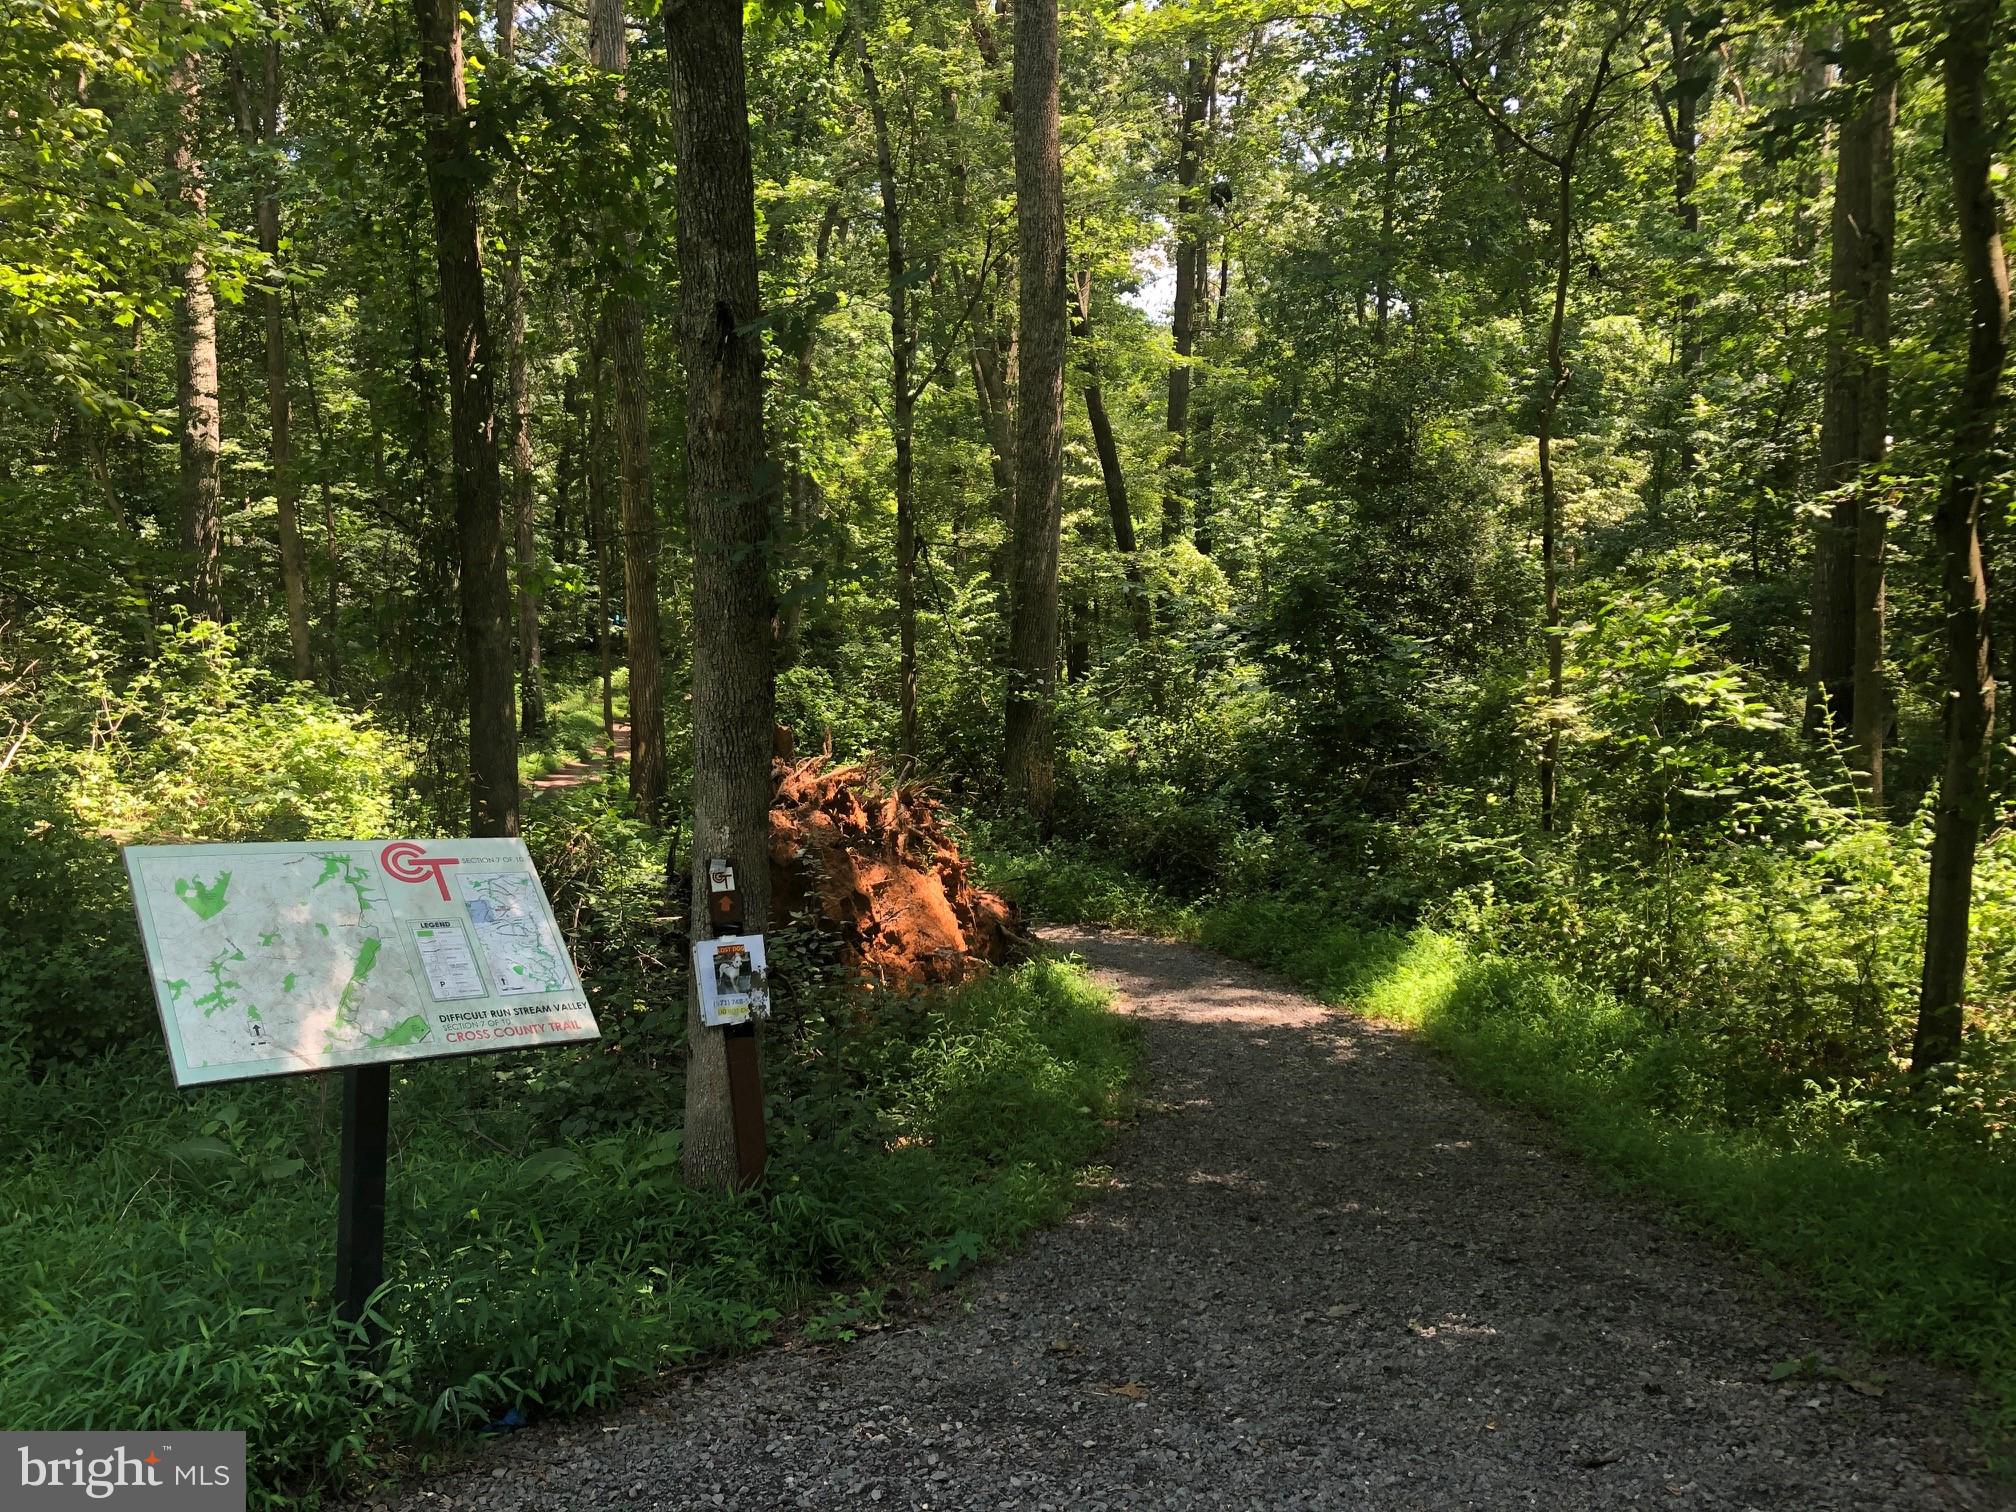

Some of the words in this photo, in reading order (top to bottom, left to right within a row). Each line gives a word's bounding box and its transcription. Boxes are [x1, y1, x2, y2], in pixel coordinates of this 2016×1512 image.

[439, 1011, 488, 1023] DIFFICULT
[490, 1009, 511, 1018] RUN
[513, 1005, 552, 1016] STREAM
[553, 1001, 587, 1012] VALLEY
[442, 1022, 479, 1032] SECTION
[487, 1019, 500, 1027] OF
[501, 1018, 512, 1026] 10
[446, 1029, 491, 1043] CROSS
[493, 1023, 545, 1038] COUNTY
[548, 1020, 582, 1032] TRAIL
